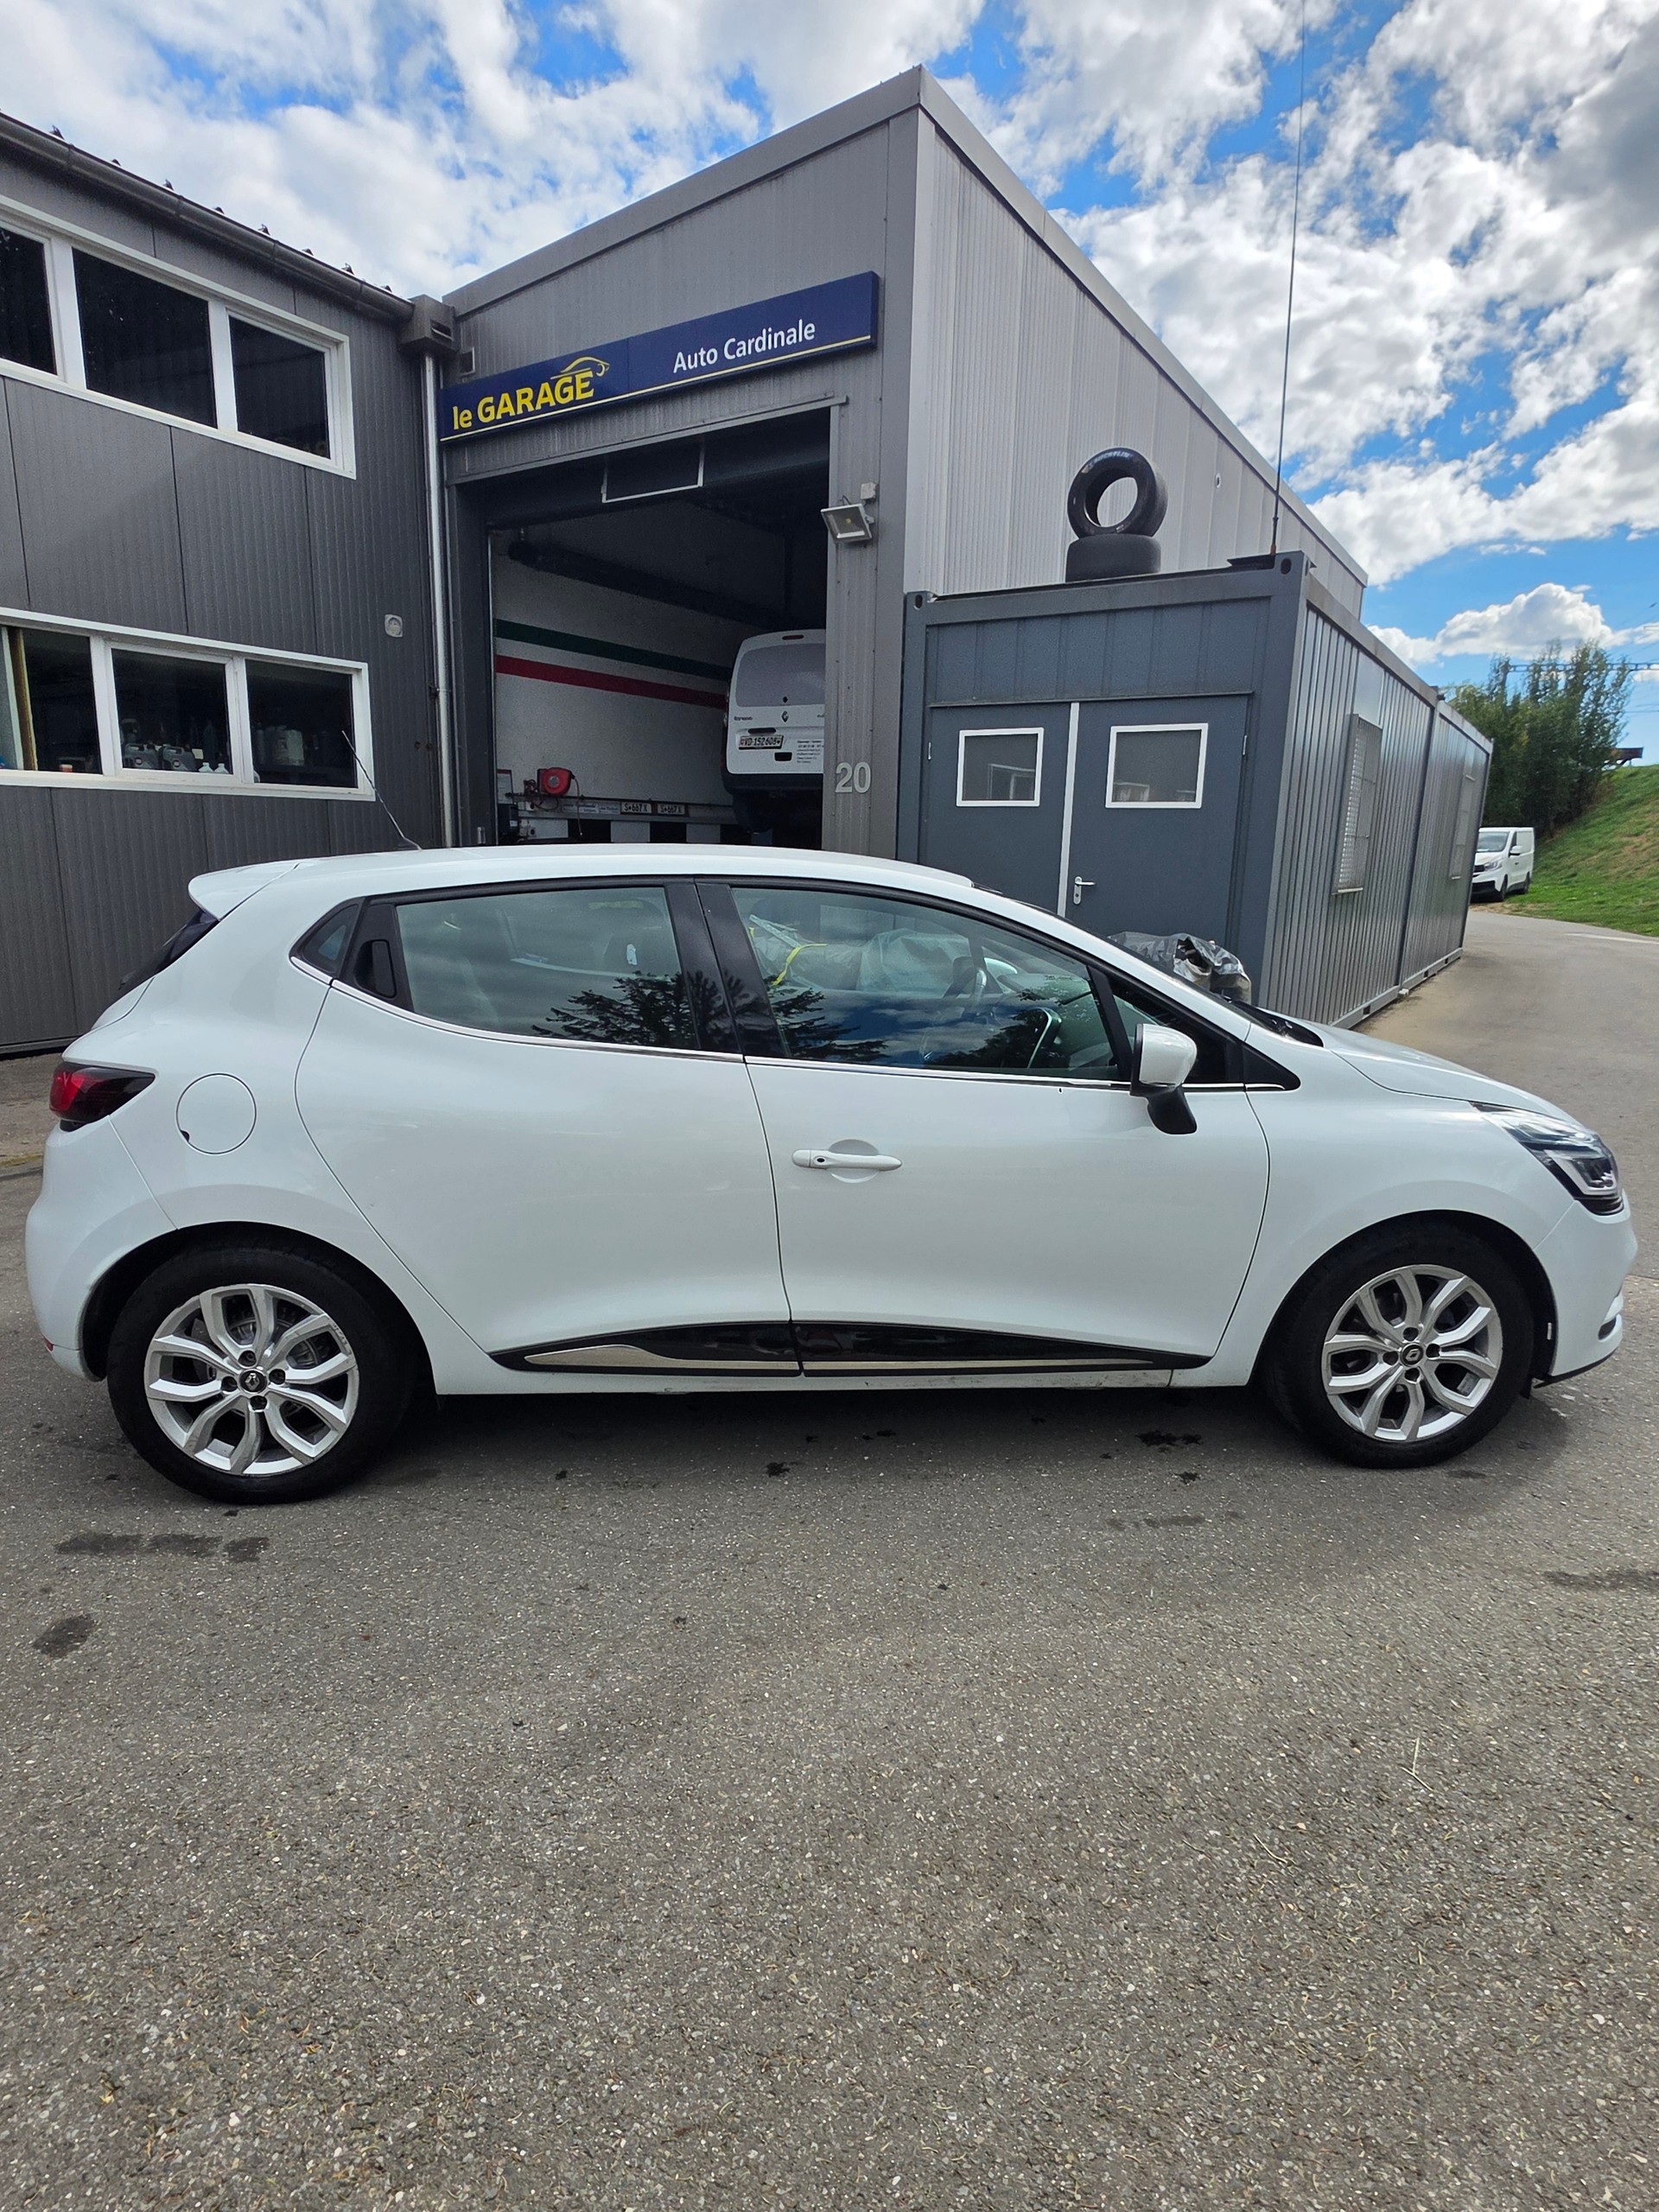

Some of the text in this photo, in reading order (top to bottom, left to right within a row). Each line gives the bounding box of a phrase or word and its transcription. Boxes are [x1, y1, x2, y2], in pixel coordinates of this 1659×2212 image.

[673, 319, 816, 373] Auto Cardinale
[452, 370, 594, 429] le GARAGE
[835, 762, 871, 793] 20
